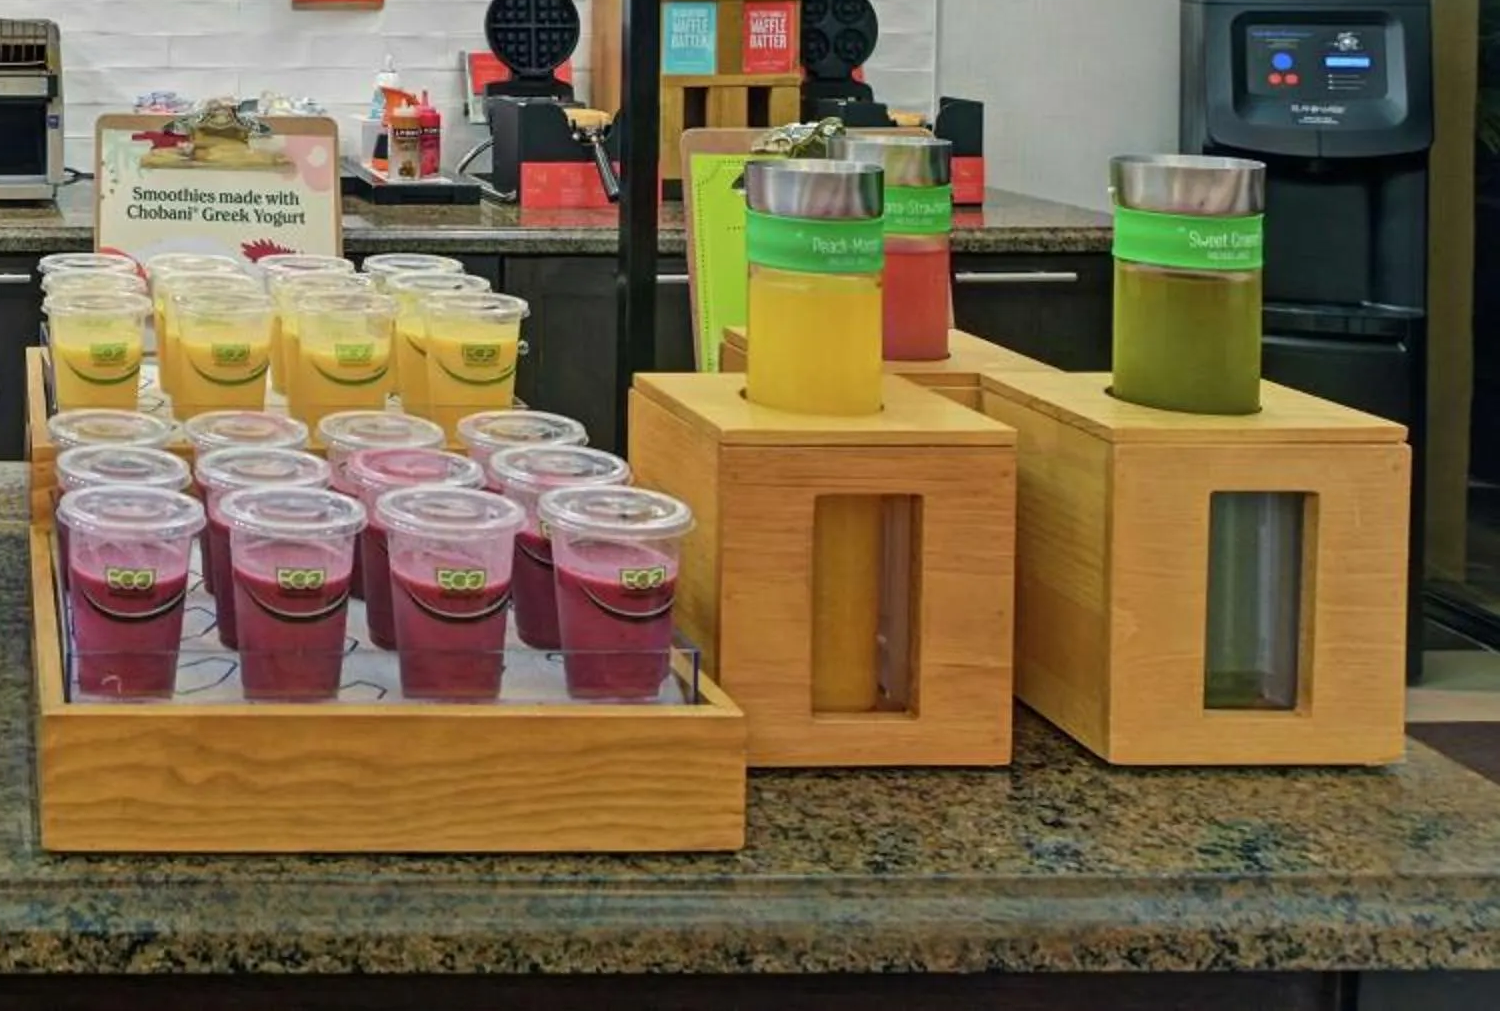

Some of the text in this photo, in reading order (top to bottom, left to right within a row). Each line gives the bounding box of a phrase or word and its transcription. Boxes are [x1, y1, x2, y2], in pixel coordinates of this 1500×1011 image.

[749, 16, 788, 33] WAFFLE
[749, 33, 787, 50] BATTER
[132, 186, 301, 206] Smoothies made with
[201, 206, 251, 223] Greek
[253, 208, 306, 227] Yogurt
